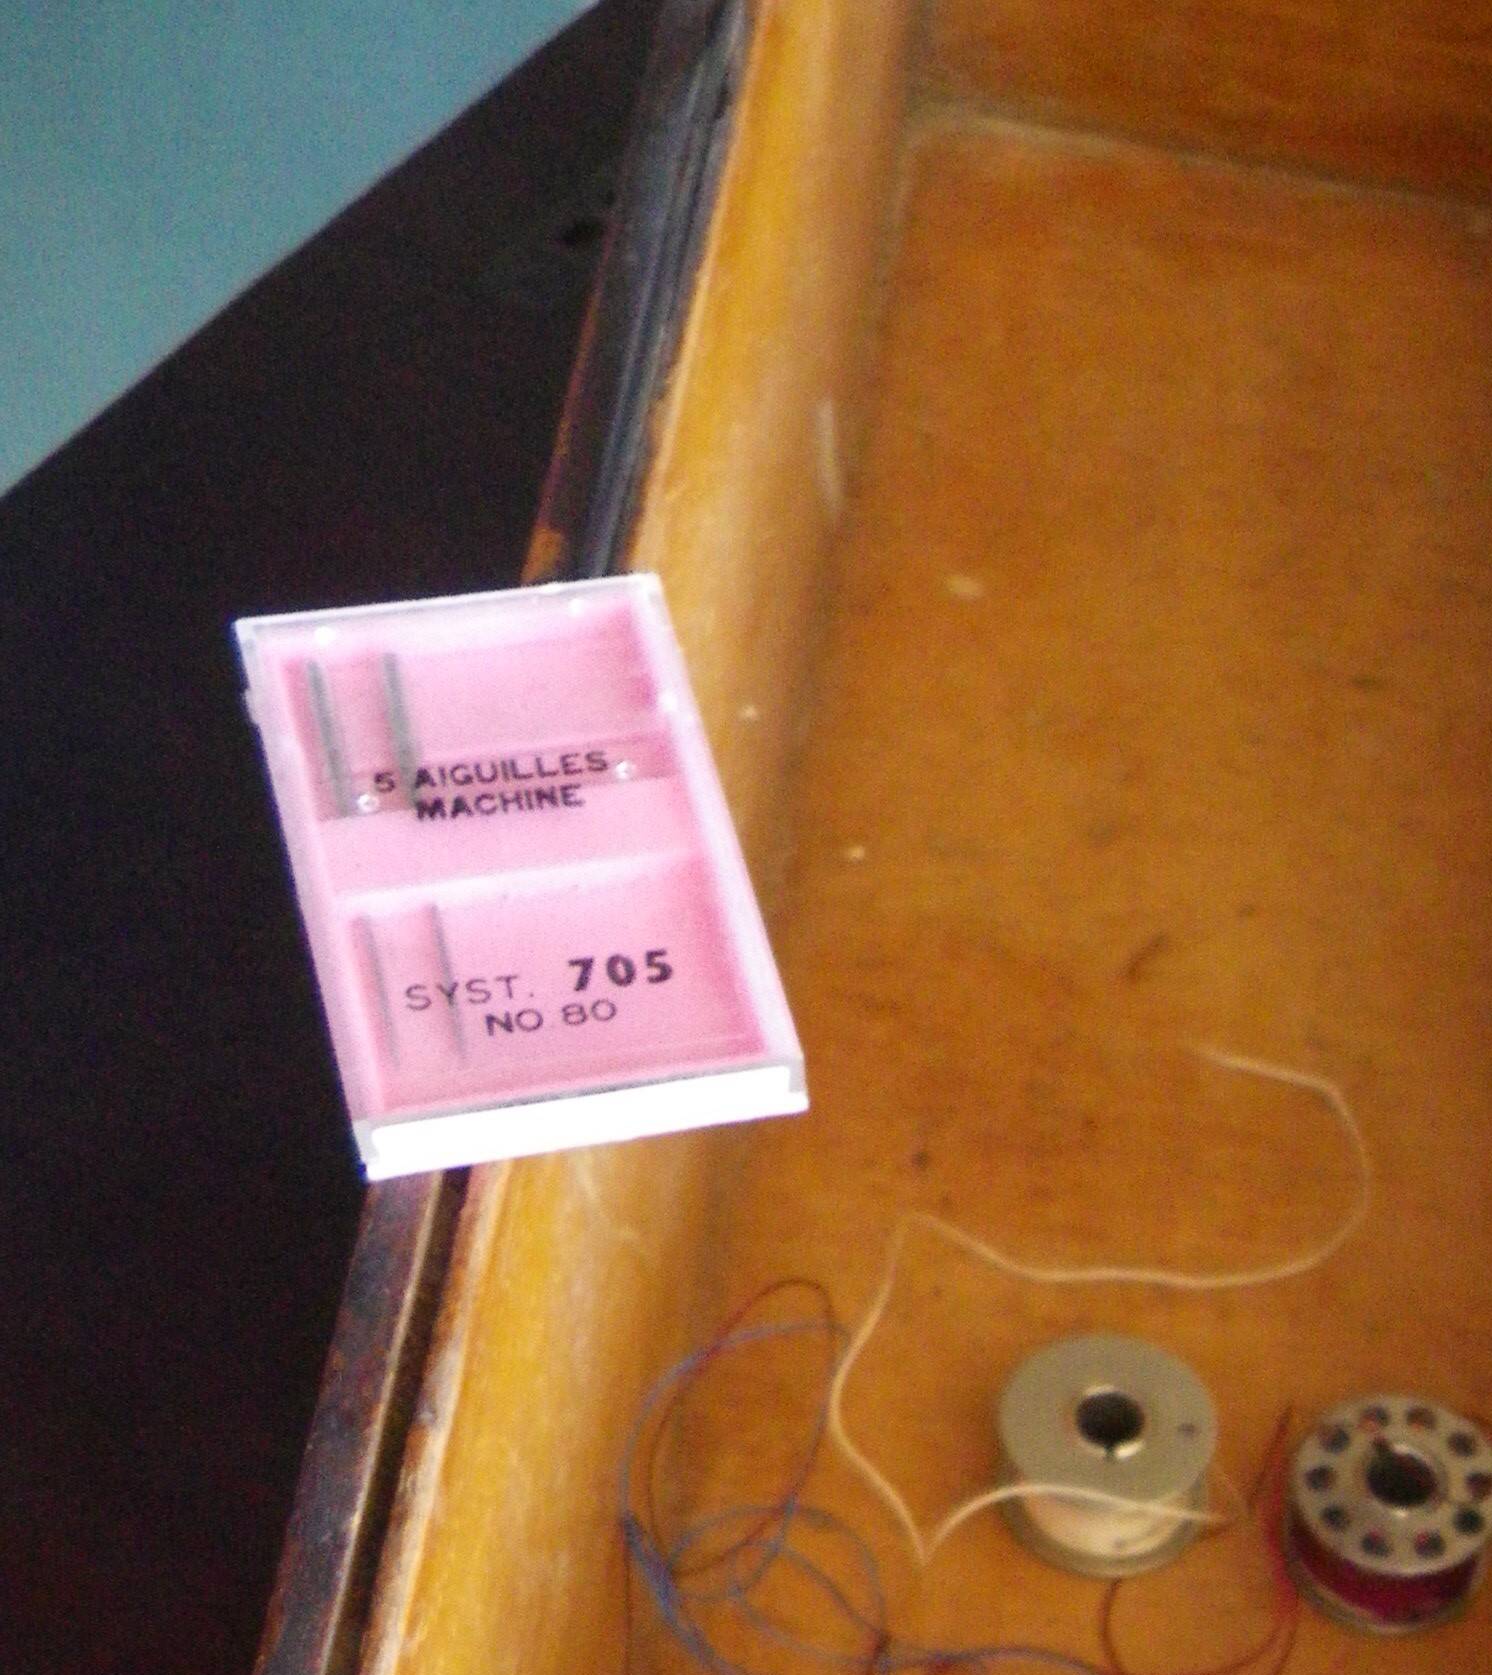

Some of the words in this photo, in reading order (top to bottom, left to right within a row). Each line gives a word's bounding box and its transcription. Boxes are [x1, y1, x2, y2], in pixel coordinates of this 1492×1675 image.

[374, 770, 396, 794] 5
[414, 749, 609, 789] AIGUILLES
[415, 782, 587, 822] MACHINE
[404, 974, 535, 1012] SYST.
[567, 948, 674, 992] 705
[484, 1008, 544, 1037] NO
[561, 998, 618, 1027] 80
